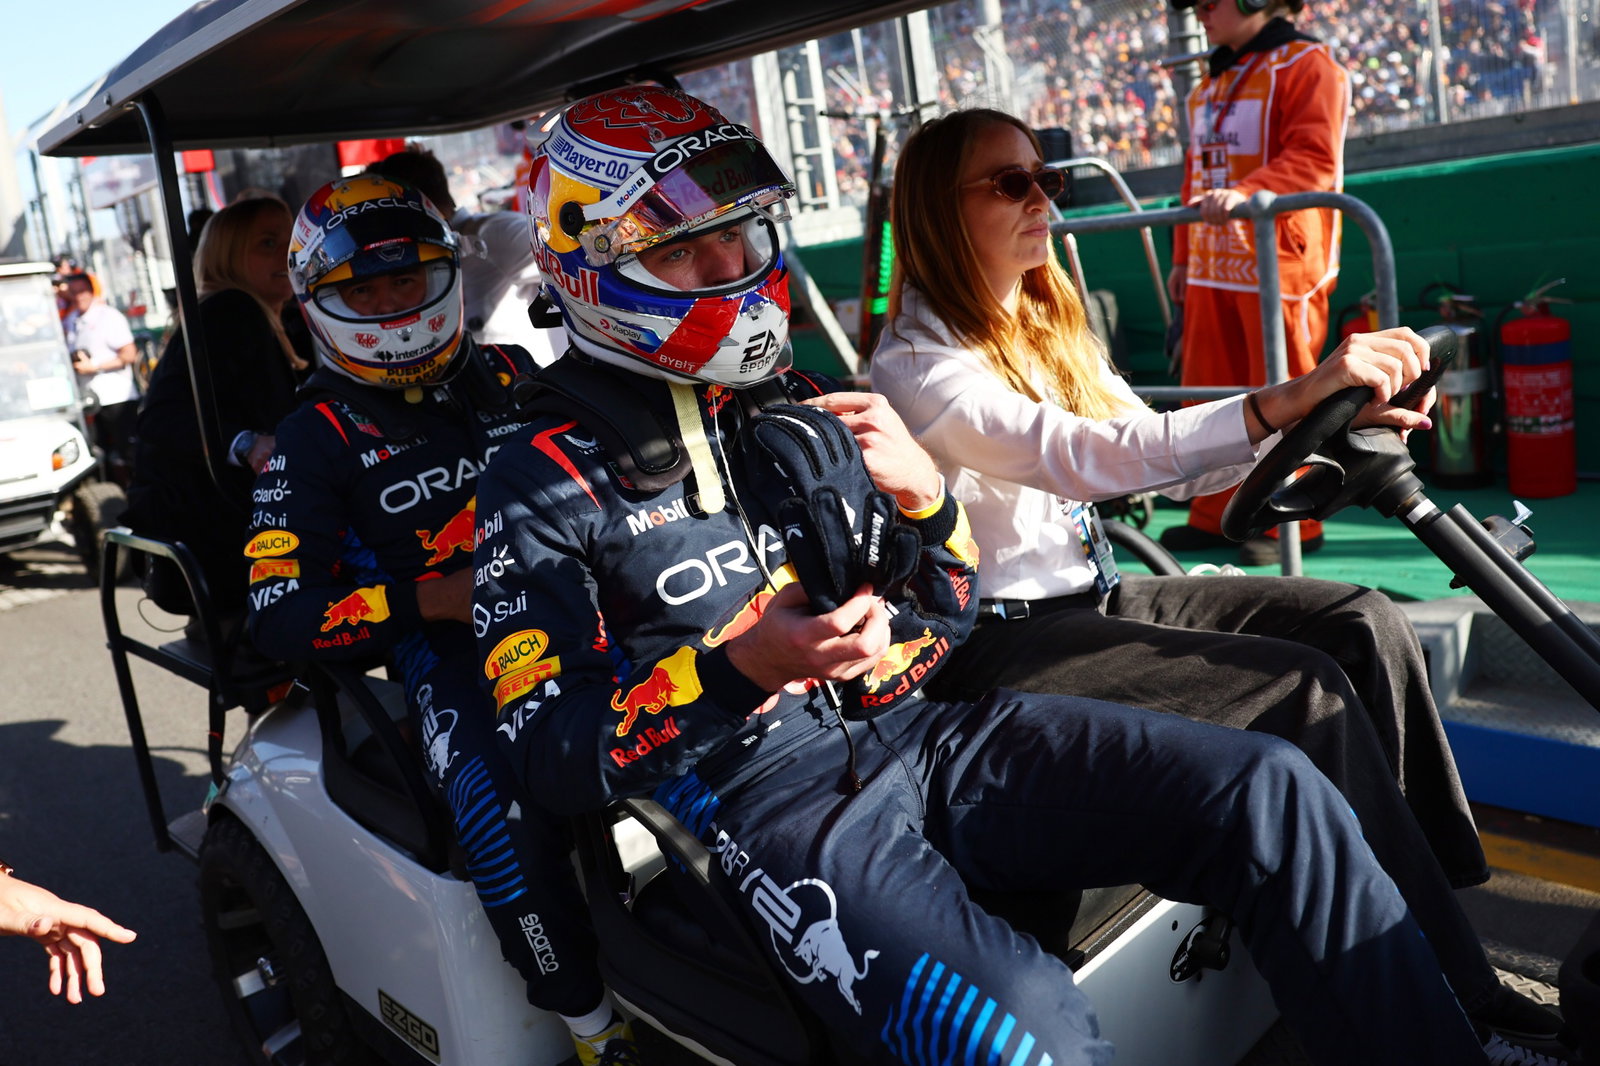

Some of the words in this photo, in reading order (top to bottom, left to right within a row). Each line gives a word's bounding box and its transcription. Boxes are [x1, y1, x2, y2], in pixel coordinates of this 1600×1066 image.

[616, 184, 639, 208] Mobil
[611, 323, 642, 341] viaplay
[741, 328, 778, 363] EA
[486, 421, 531, 438] HON
[262, 455, 286, 474] obil
[380, 445, 503, 514] ORA
[625, 498, 690, 537] Mobil
[255, 536, 291, 552] RAUCH
[656, 523, 785, 606] ORA
[249, 578, 300, 612] VISA
[493, 590, 527, 623] Sui
[312, 633, 342, 650] Red
[498, 634, 542, 672] RAUCH
[861, 674, 911, 709] Red
[909, 636, 950, 684] Bull
[609, 733, 654, 769] Red
[644, 715, 682, 748] Bull
[520, 913, 560, 973] sparco
